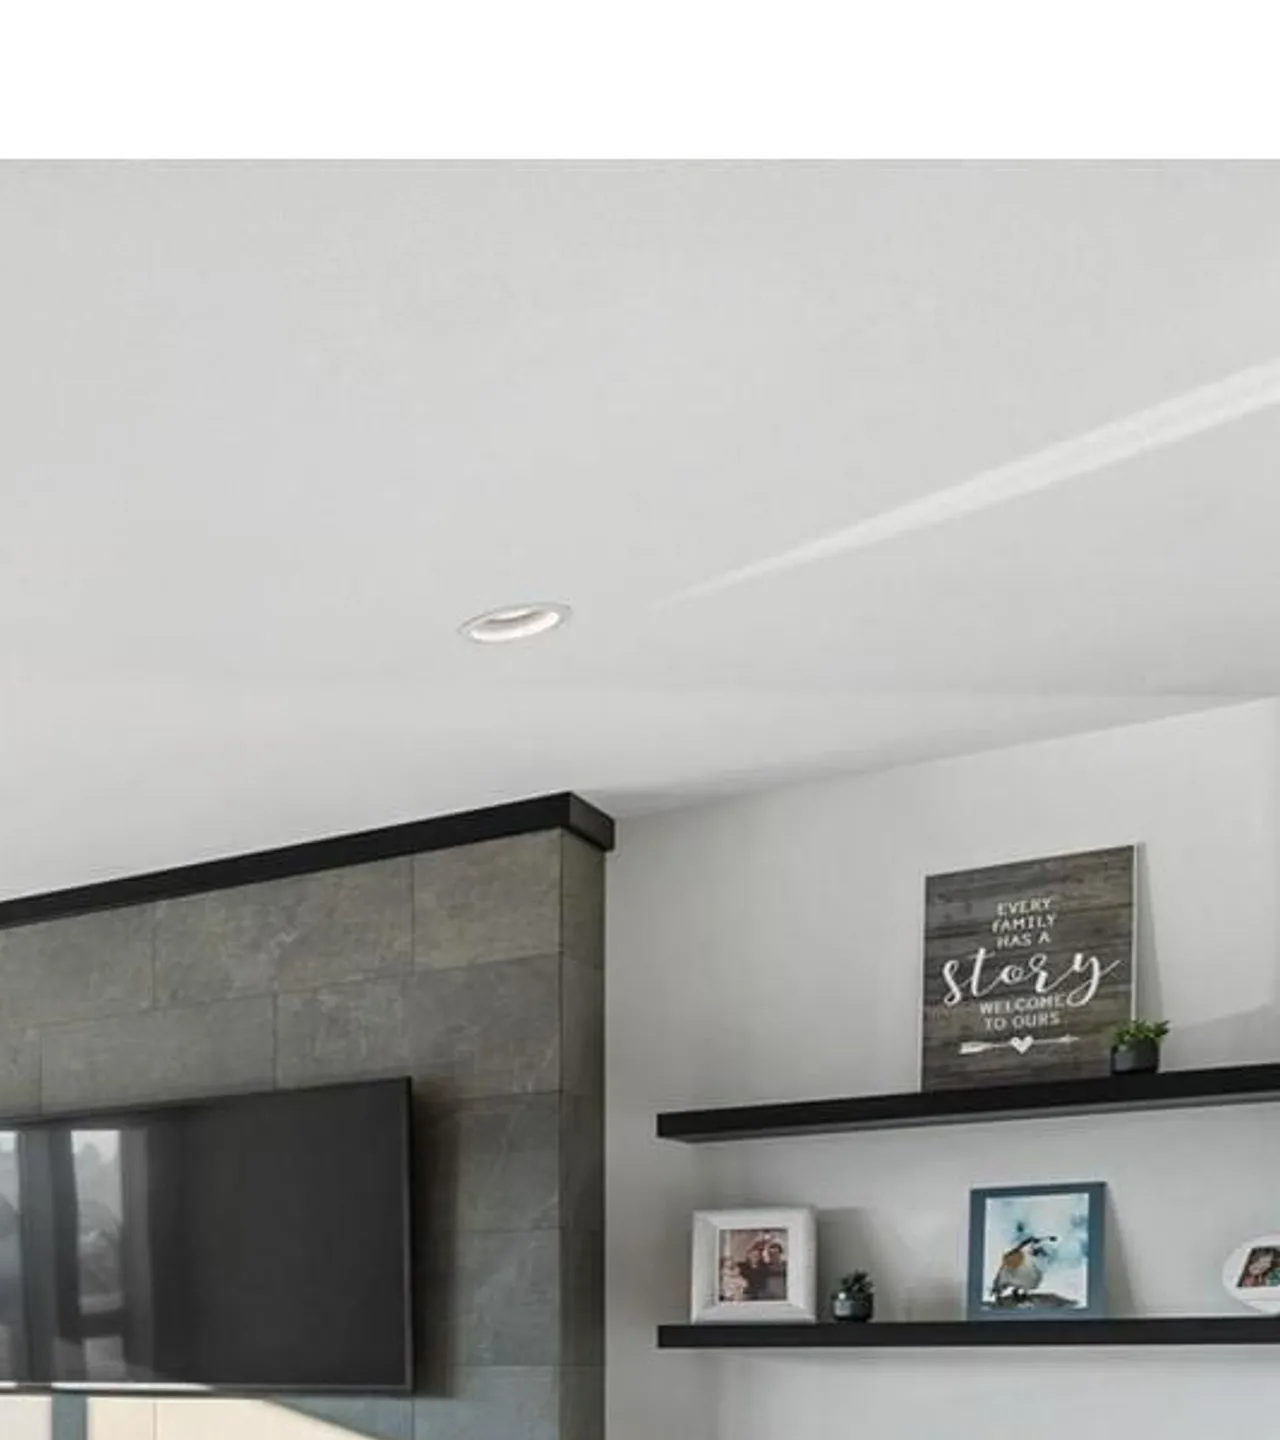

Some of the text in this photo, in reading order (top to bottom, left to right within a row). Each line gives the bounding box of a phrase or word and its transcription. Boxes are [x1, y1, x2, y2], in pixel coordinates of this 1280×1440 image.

[997, 897, 1053, 916] EVERY
[992, 914, 1056, 933] FAMILY
[997, 932, 1051, 949] HAS A
[942, 947, 1121, 1006] story
[980, 995, 1066, 1015] WELCOME
[984, 1012, 1060, 1030] TO OURS
